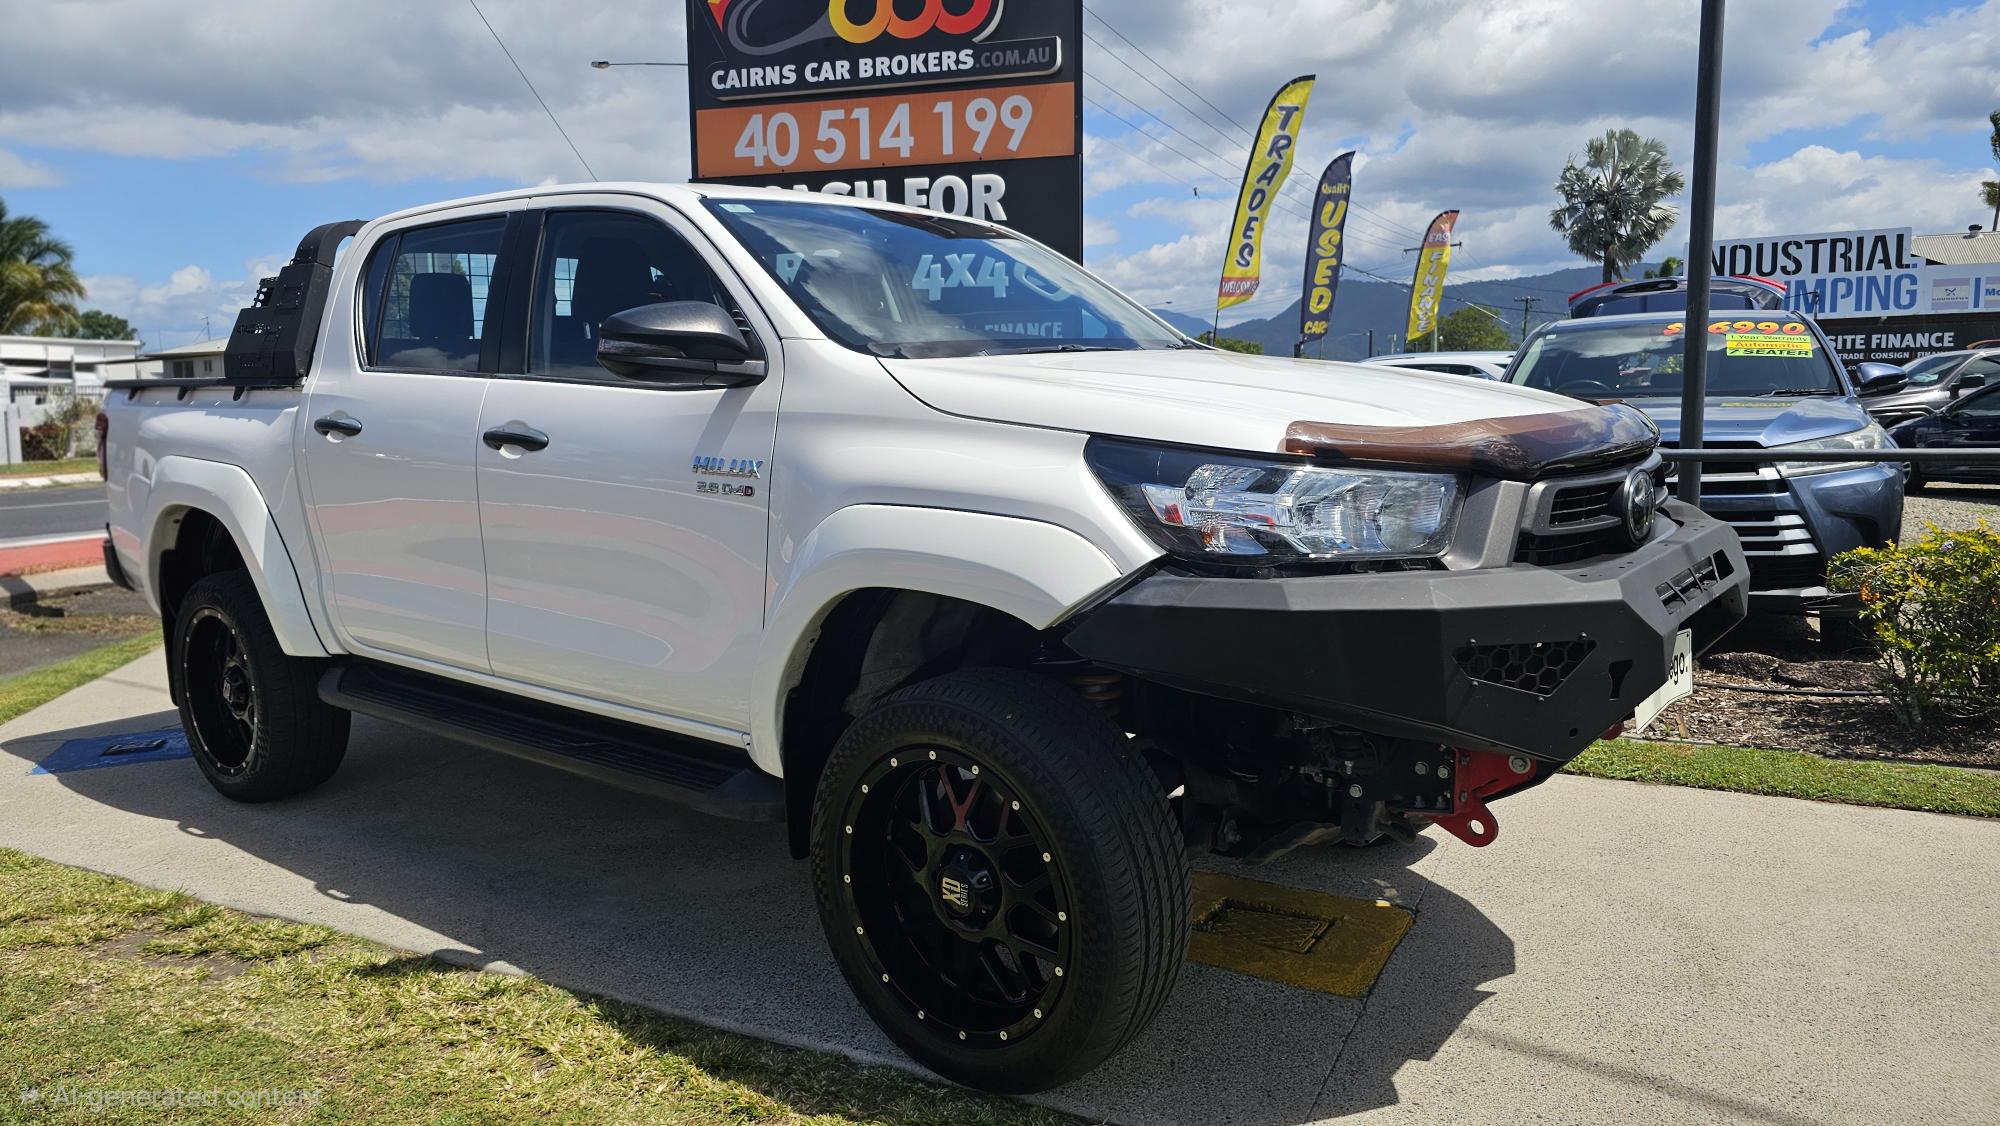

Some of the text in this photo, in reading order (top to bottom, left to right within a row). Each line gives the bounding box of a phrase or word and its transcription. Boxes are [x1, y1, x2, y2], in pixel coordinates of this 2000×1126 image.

[711, 46, 1051, 91] CAIRNS CAR BROKERS.COM.AU
[734, 94, 1033, 168] 40 514 199
[903, 173, 1008, 221] FOR
[1235, 105, 1300, 268] TRADES
[1308, 200, 1348, 314] USED
[911, 253, 1009, 300] 4X4
[1783, 273, 1918, 315] MPING
[1303, 320, 1329, 334] CAR
[1871, 332, 1954, 349] FINANCE
[1735, 341, 1804, 349] Automatic
[1838, 352, 1865, 360] TRADE
[691, 455, 764, 479] HILUX
[942, 877, 960, 905] XD
[960, 883, 969, 907] SERIES
